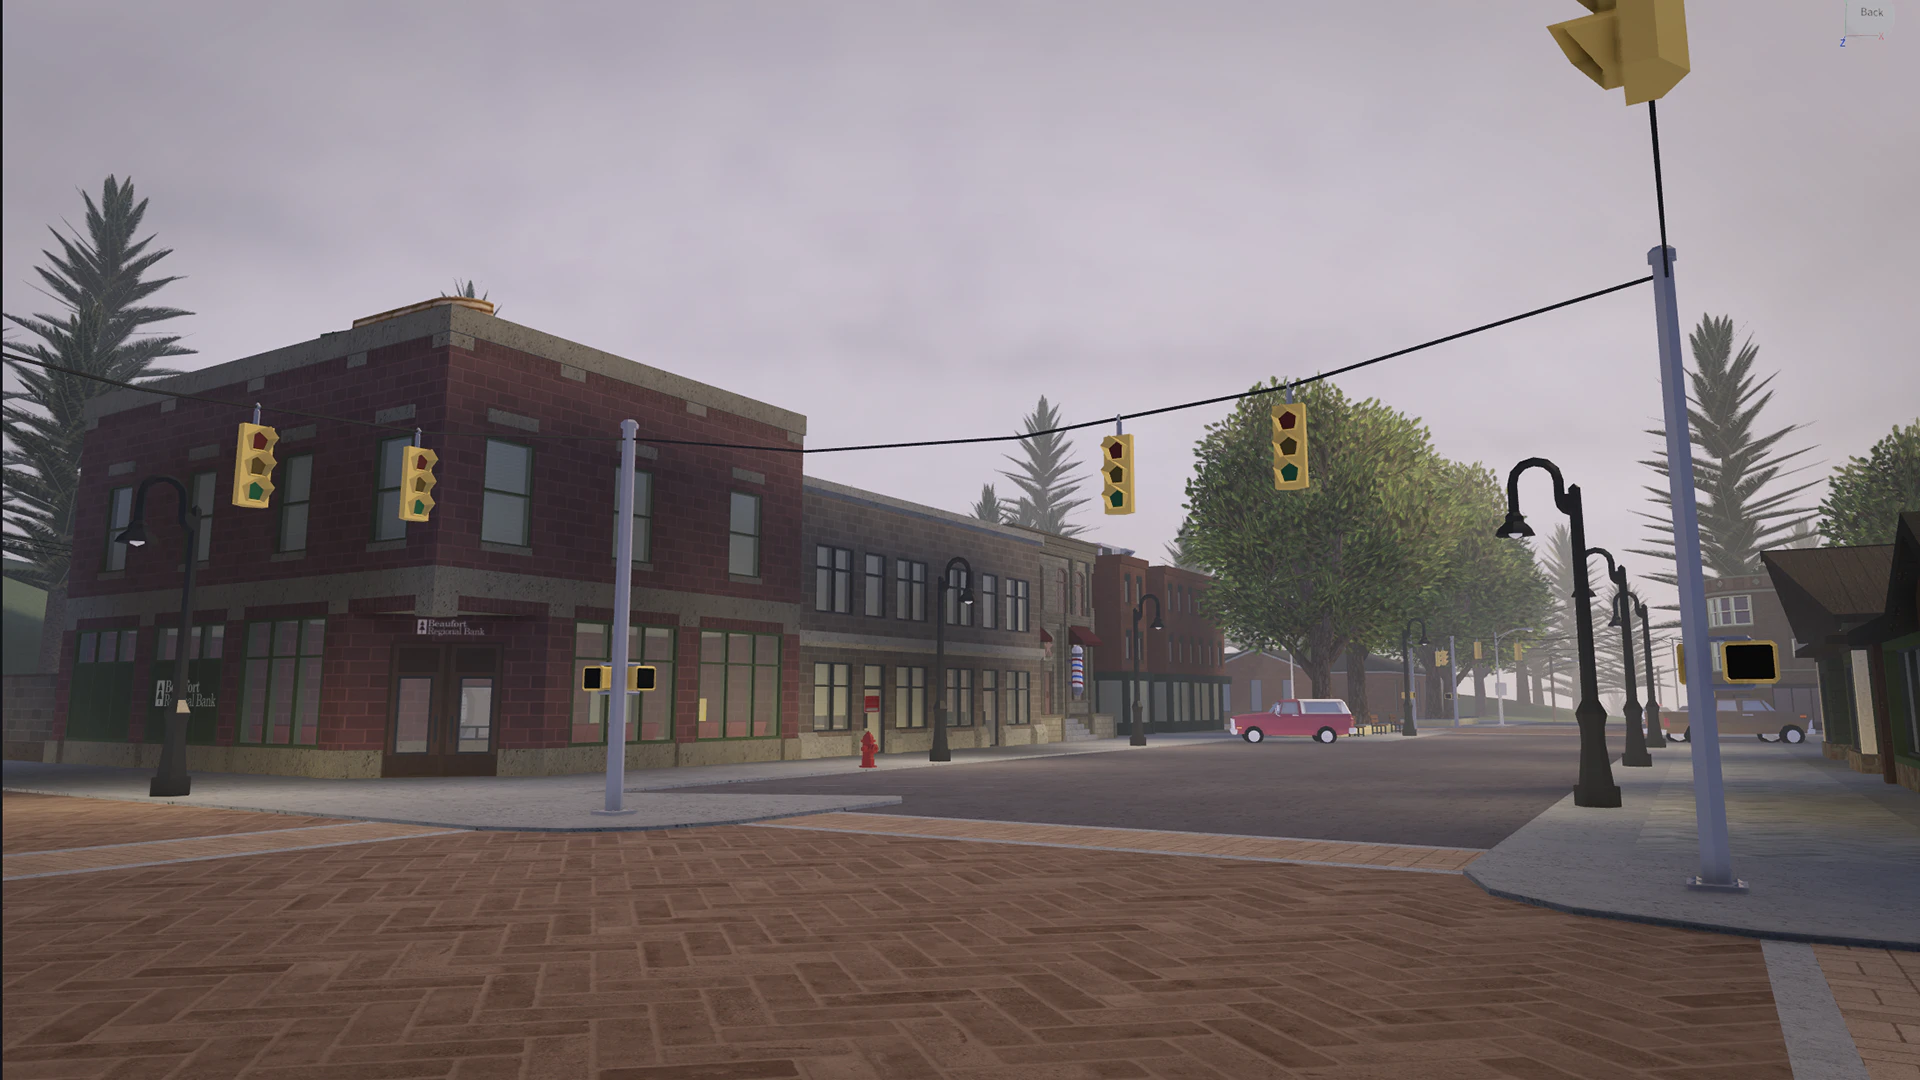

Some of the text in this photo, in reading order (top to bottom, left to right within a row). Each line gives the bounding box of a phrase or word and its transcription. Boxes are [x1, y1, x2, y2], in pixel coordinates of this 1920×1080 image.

[429, 619, 467, 628] Beaufort
[428, 627, 485, 637] Regional Bank
[195, 693, 216, 707] Bank
